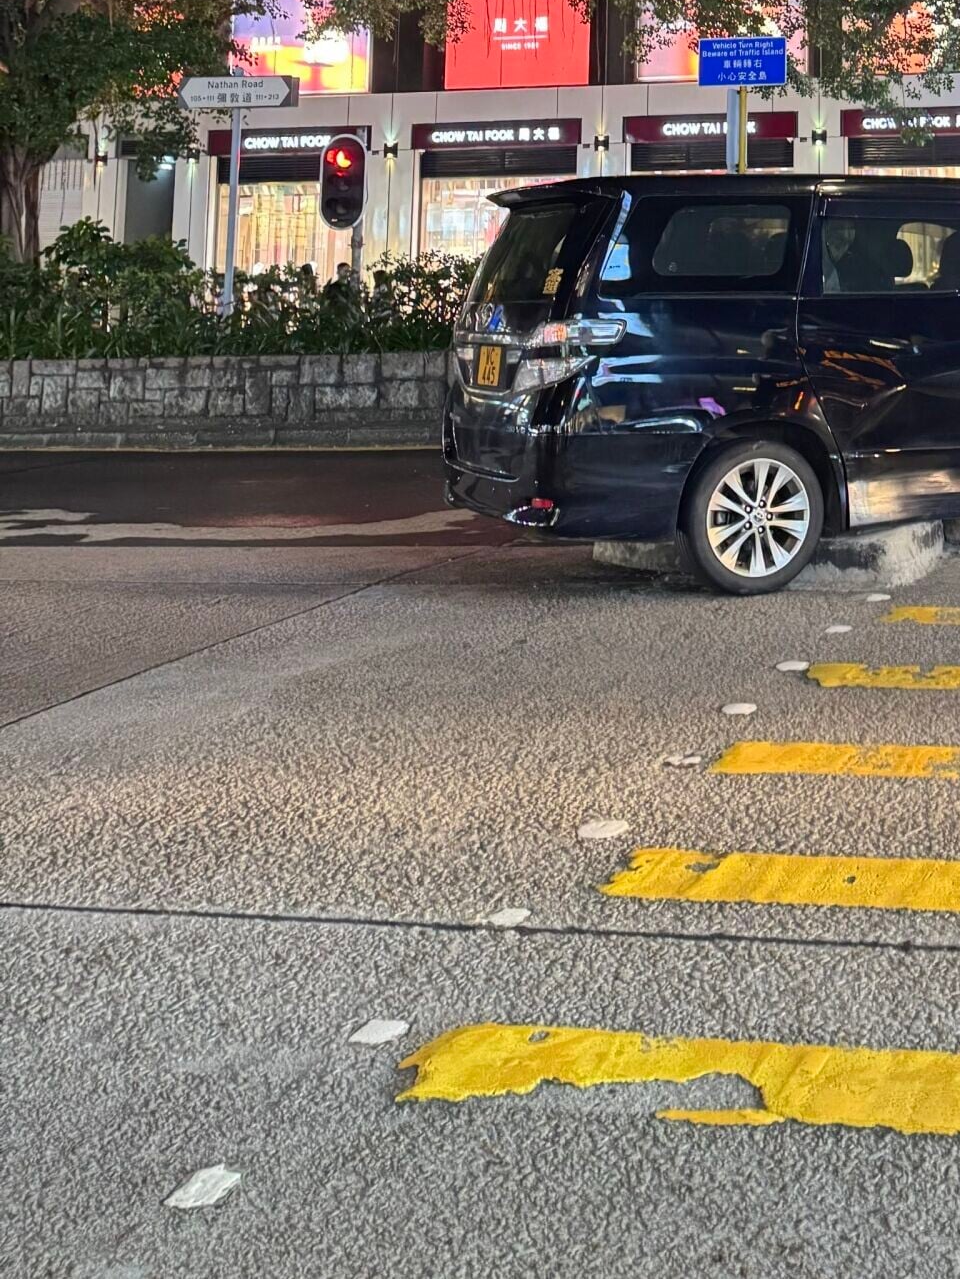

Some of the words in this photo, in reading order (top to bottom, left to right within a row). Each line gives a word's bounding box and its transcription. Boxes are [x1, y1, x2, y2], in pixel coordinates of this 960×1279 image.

[712, 42, 737, 50] Vehicle
[754, 40, 774, 49] Right
[729, 49, 737, 57] of
[739, 48, 760, 56] Traffic
[762, 47, 784, 56] Island
[717, 70, 767, 81] 小心安全島
[207, 80, 239, 89] Nathan
[241, 79, 264, 88] Road
[662, 122, 700, 136] CHOW
[702, 122, 721, 135] TAI
[431, 130, 465, 143] CHOW
[466, 130, 483, 142] TAI
[485, 129, 514, 141] FOOK
[518, 127, 560, 141] 周大福
[244, 136, 279, 150] CHOW
[281, 135, 298, 148] TAI
